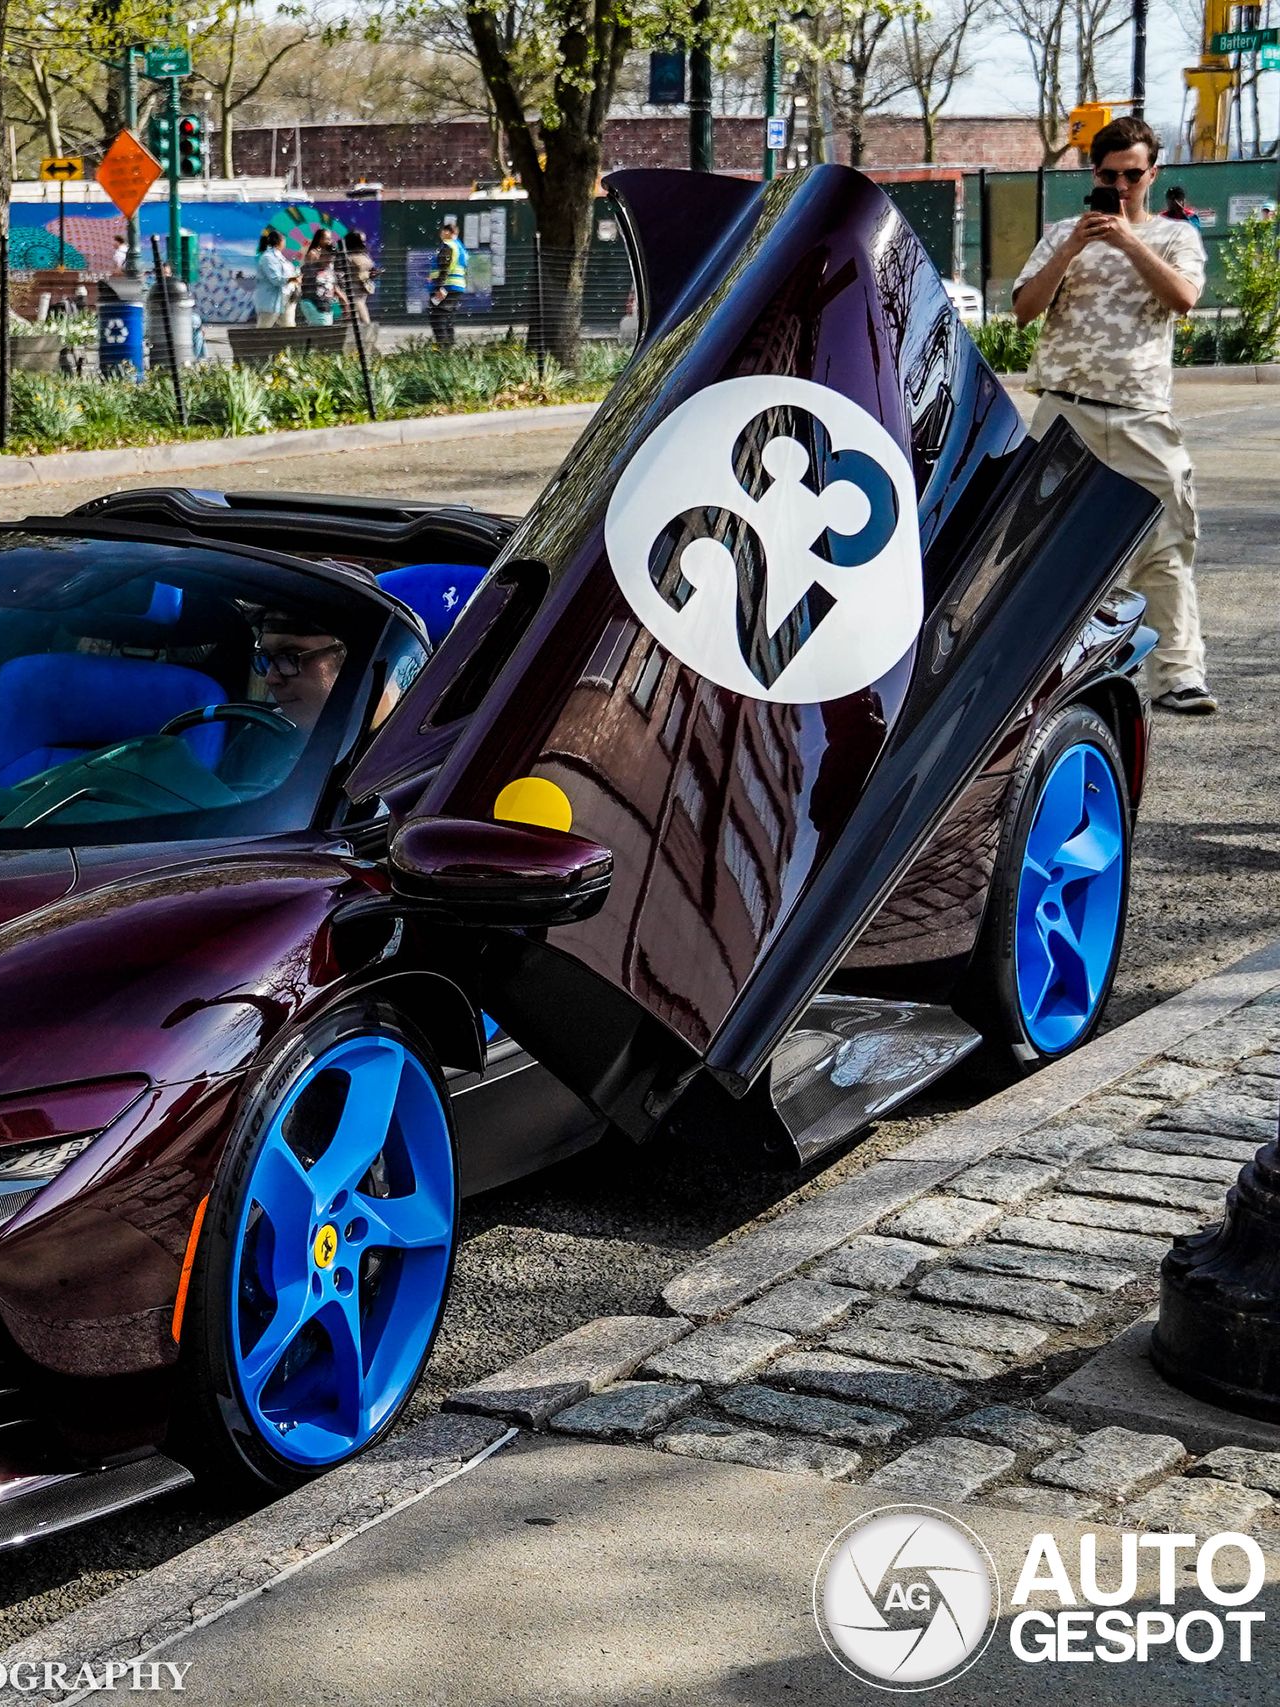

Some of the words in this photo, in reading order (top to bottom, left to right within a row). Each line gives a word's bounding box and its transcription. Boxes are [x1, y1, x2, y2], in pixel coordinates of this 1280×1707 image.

[1220, 34, 1257, 51] Battery
[648, 405, 899, 690] 23
[271, 1047, 309, 1100] CORSA
